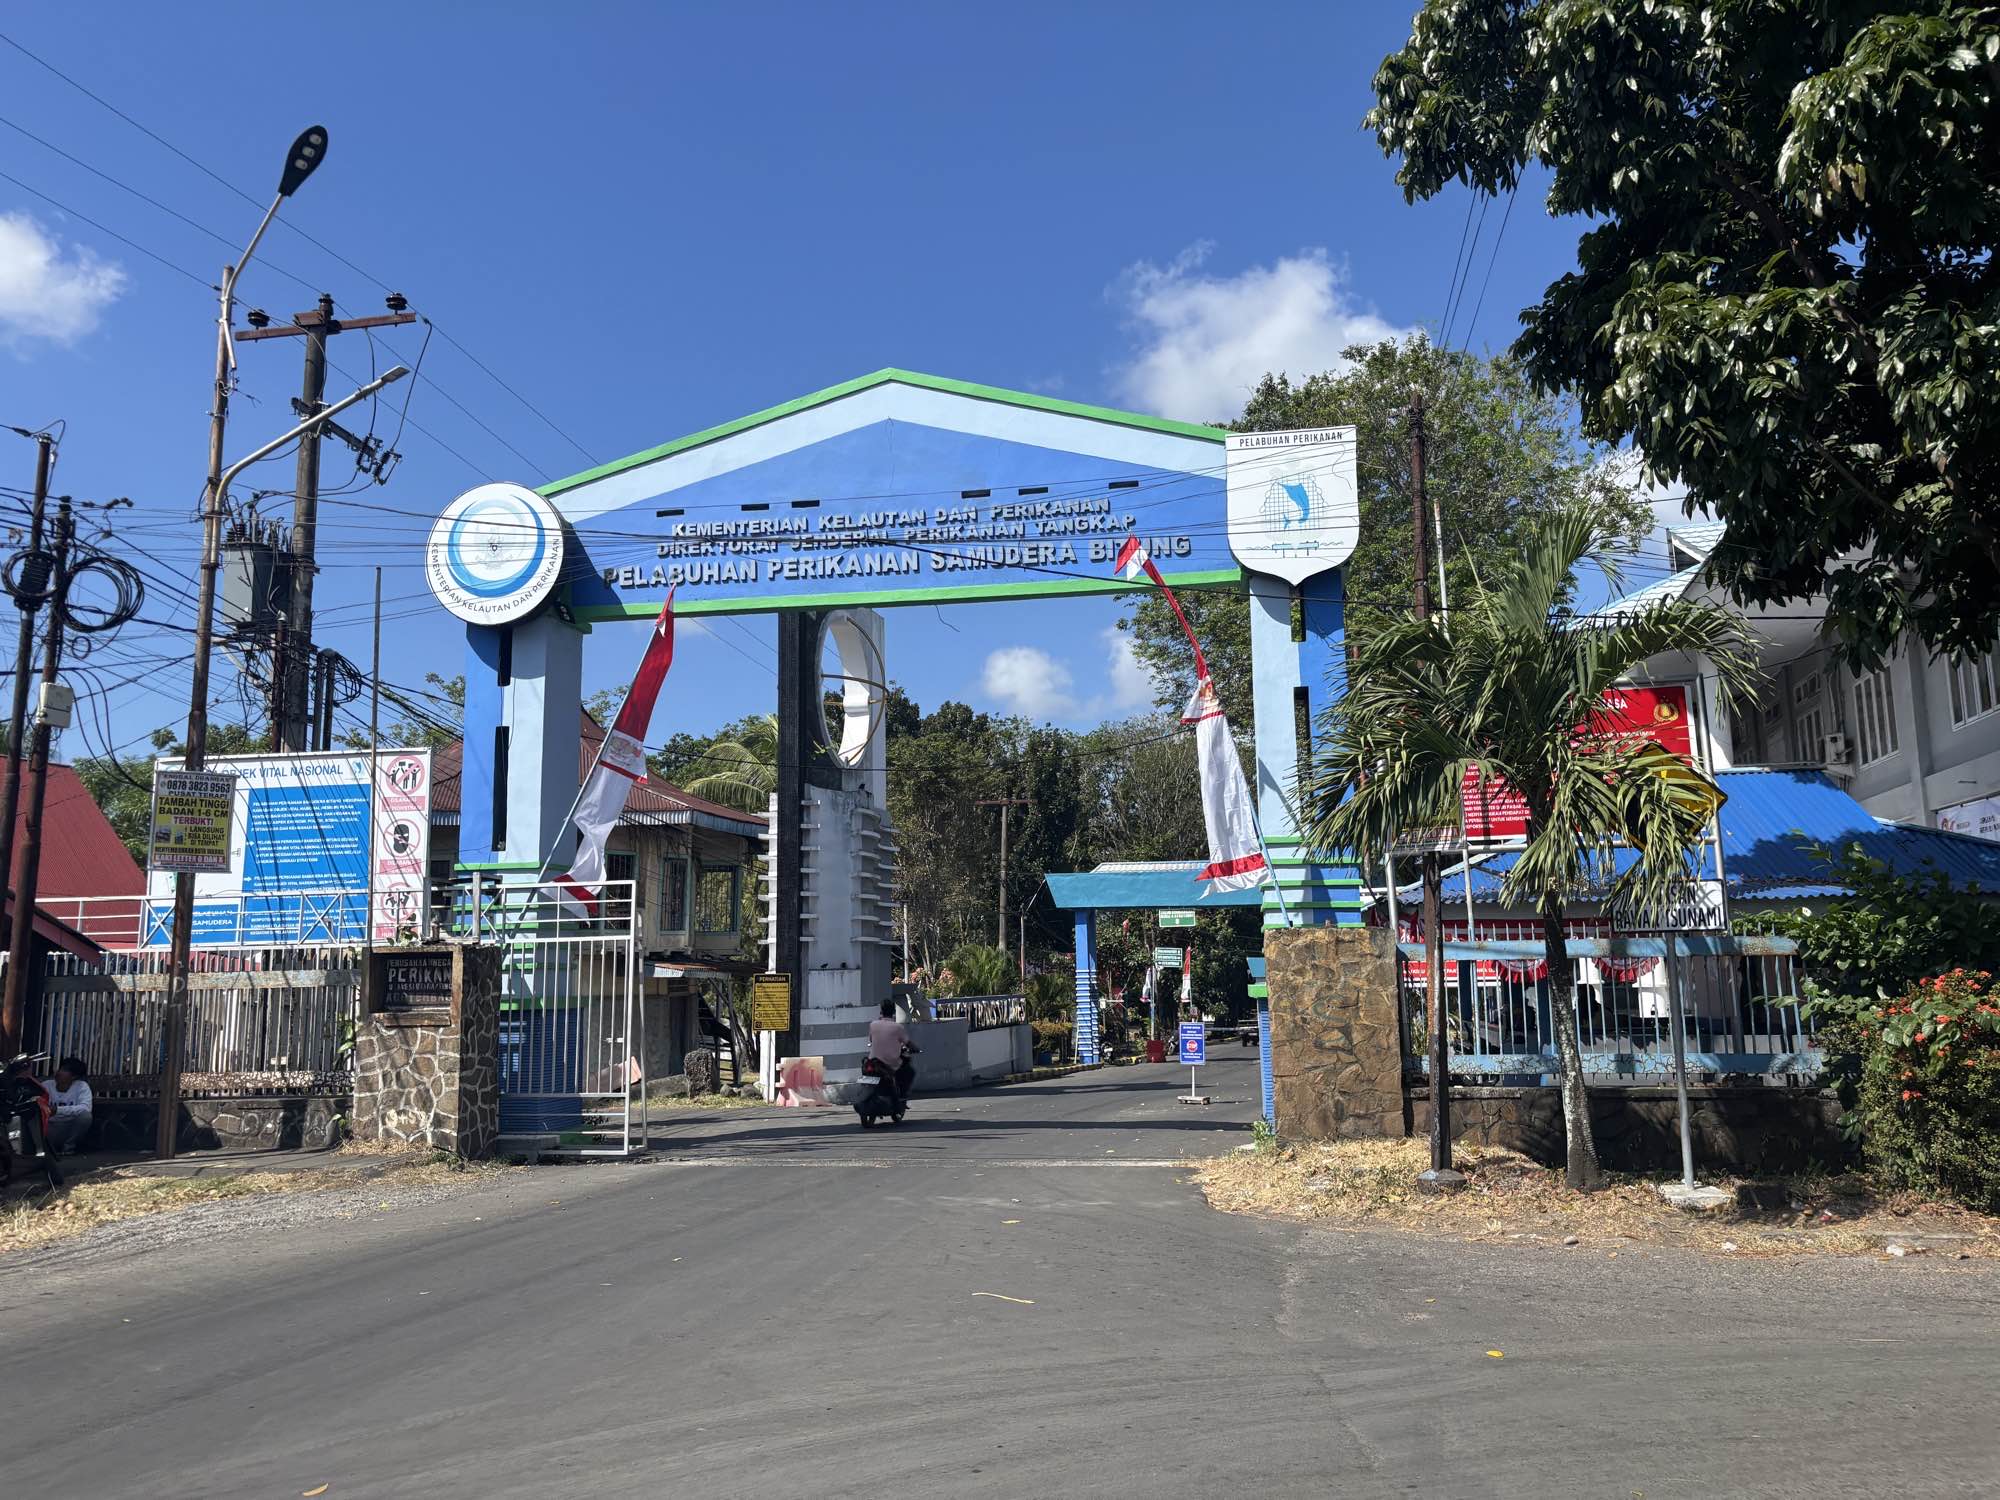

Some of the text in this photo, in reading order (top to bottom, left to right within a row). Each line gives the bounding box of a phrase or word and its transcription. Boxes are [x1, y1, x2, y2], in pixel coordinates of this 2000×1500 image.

[1239, 431, 1343, 447] PELABUHAN PERIKANAN
[671, 498, 1110, 537] KEMENTERIAN KELAUTAN DAN PERIKANAN
[903, 521, 1025, 543] PERIKANAN
[1035, 513, 1137, 535] TANGKAP
[604, 536, 1191, 589] PELABUHAN PERIKANAN SAMUDERA BIUNG
[431, 538, 560, 613] KEMENTERIAN KELAUTAN DAN PERIKANAN
[260, 766, 288, 778] VITAL
[290, 764, 343, 777] NASIONAL
[167, 780, 187, 791] 0878
[210, 782, 231, 793] 9563
[168, 790, 197, 798] PUSAT
[159, 796, 229, 809] TAMBAH TINGGI
[159, 807, 229, 818] BADAN 1-6 CM
[174, 816, 214, 825] TERBUKTI
[1665, 906, 1722, 928] TSUNAMI
